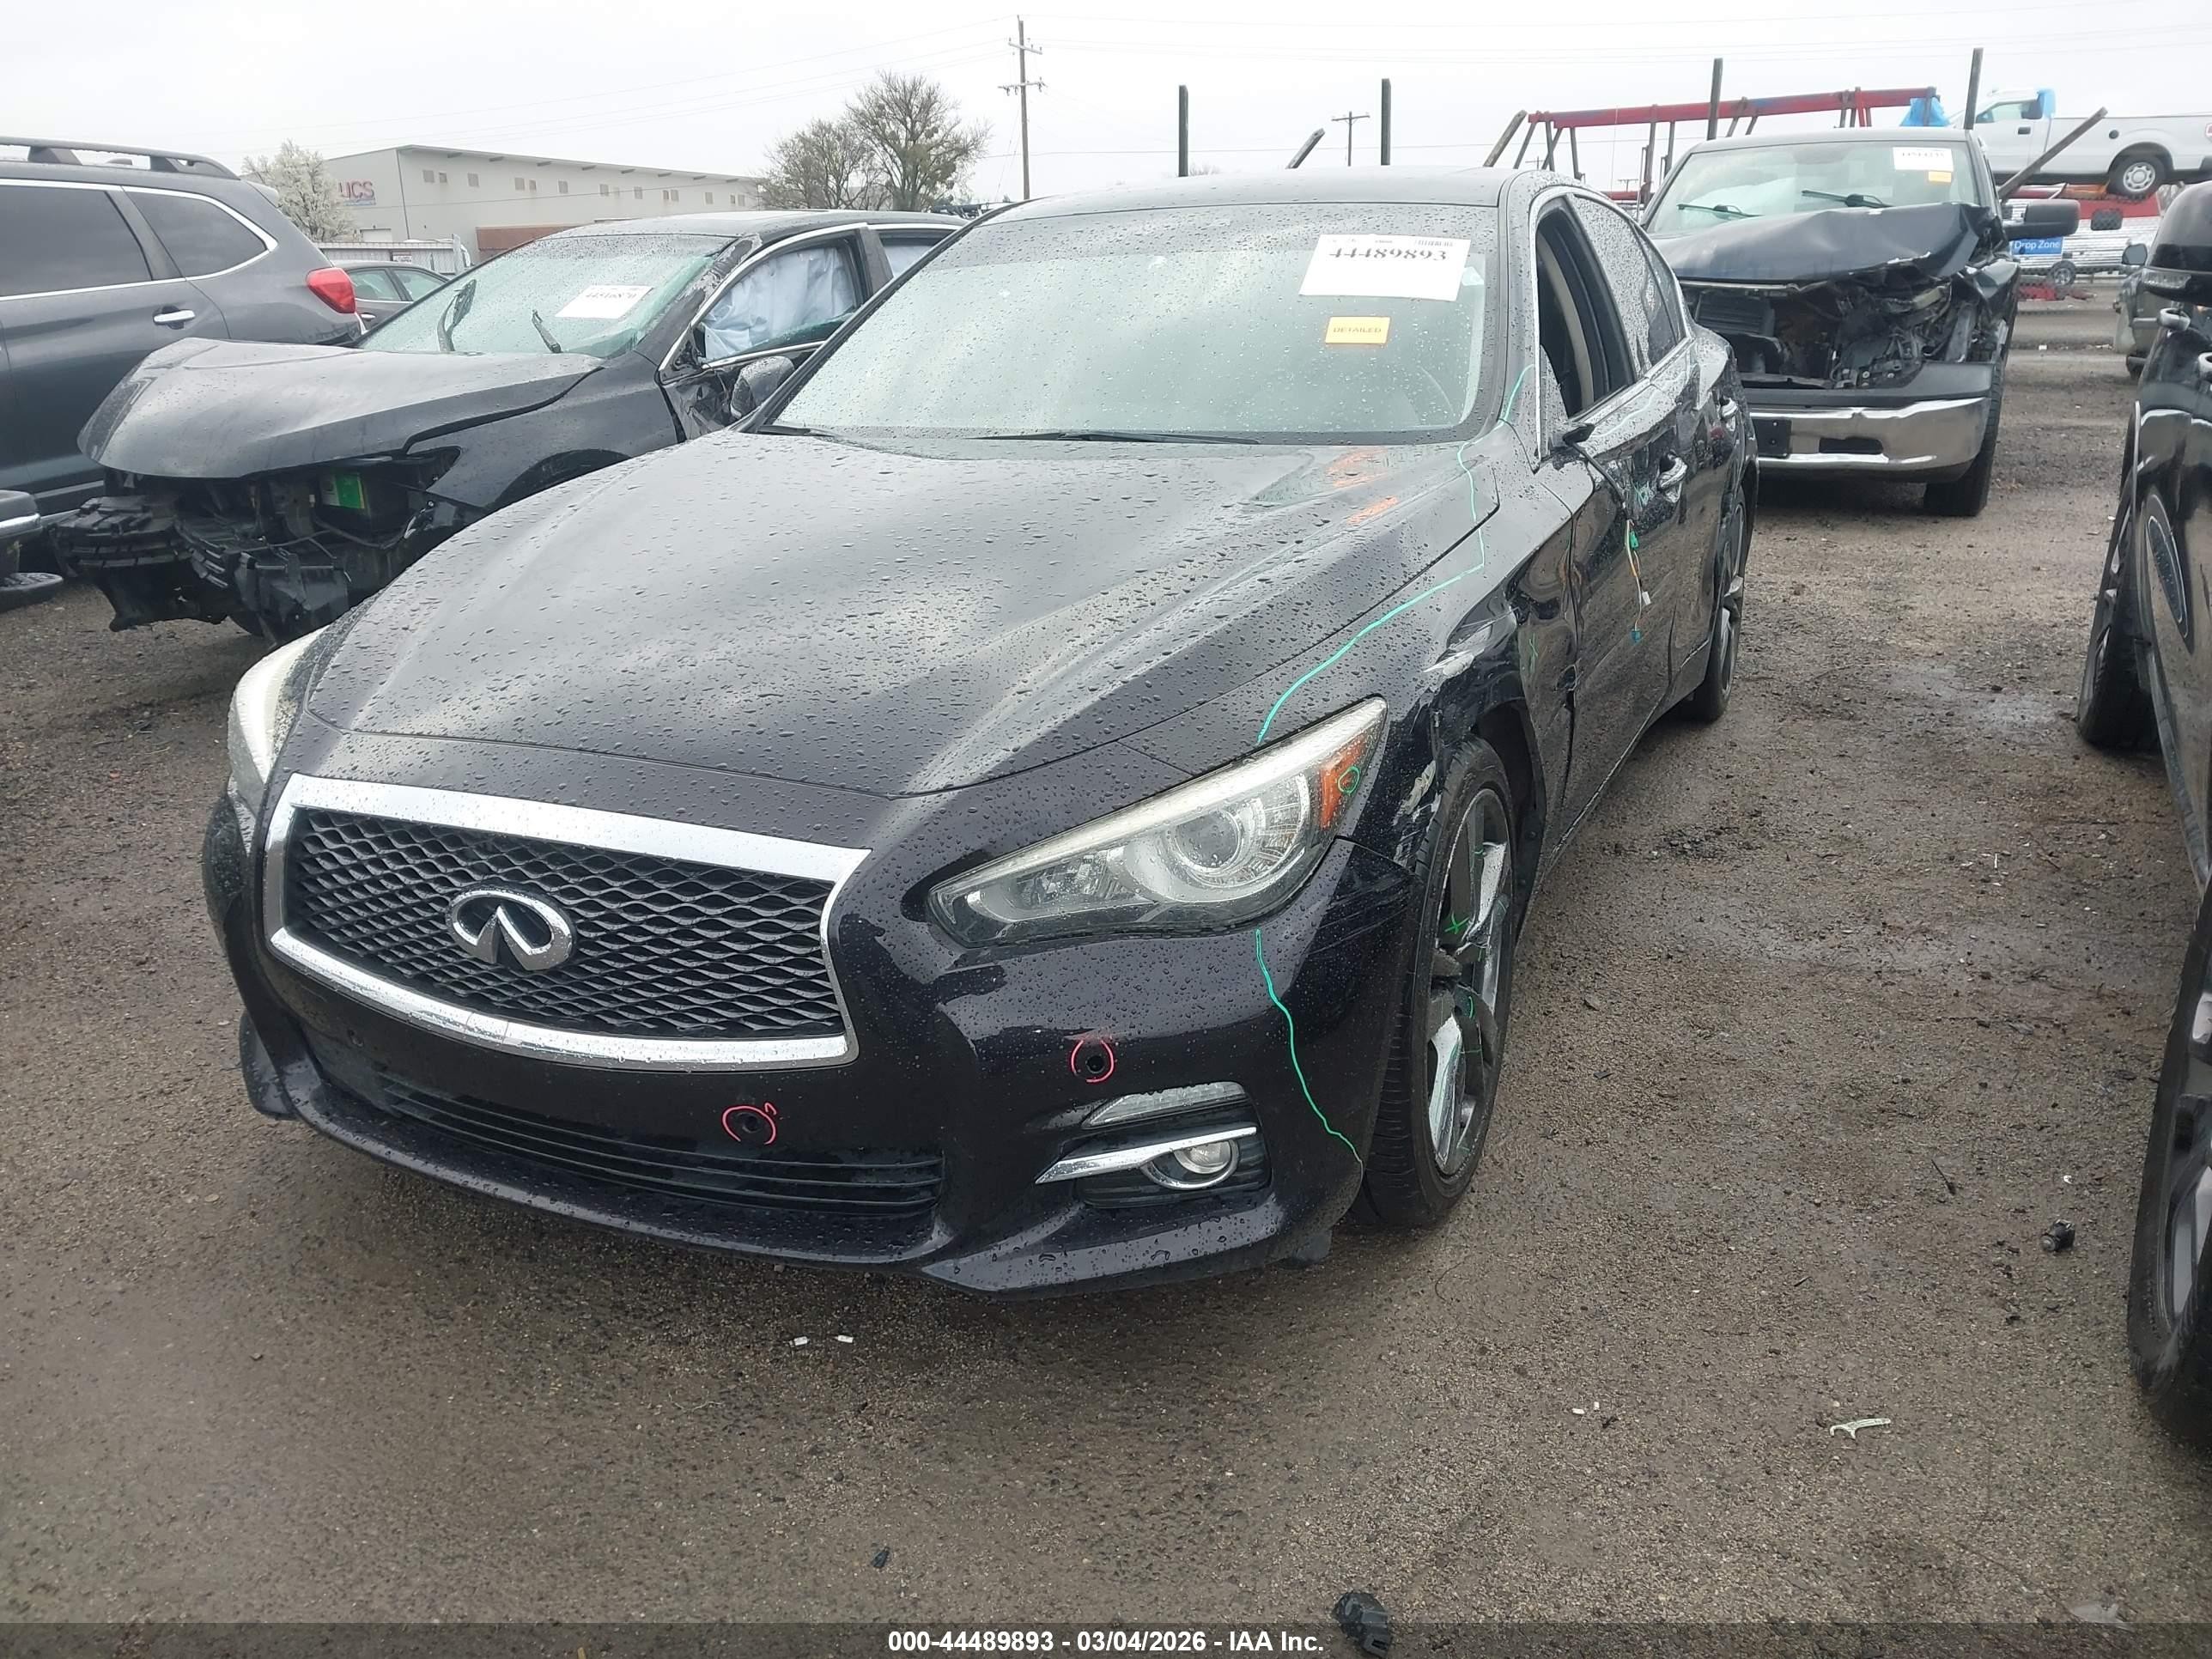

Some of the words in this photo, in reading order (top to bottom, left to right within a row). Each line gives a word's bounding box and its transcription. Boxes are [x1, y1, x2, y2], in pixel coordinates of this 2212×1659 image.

[2014, 240, 2037, 251] Drop
[2038, 240, 2061, 249] Zone
[1329, 247, 1447, 261] 44489893
